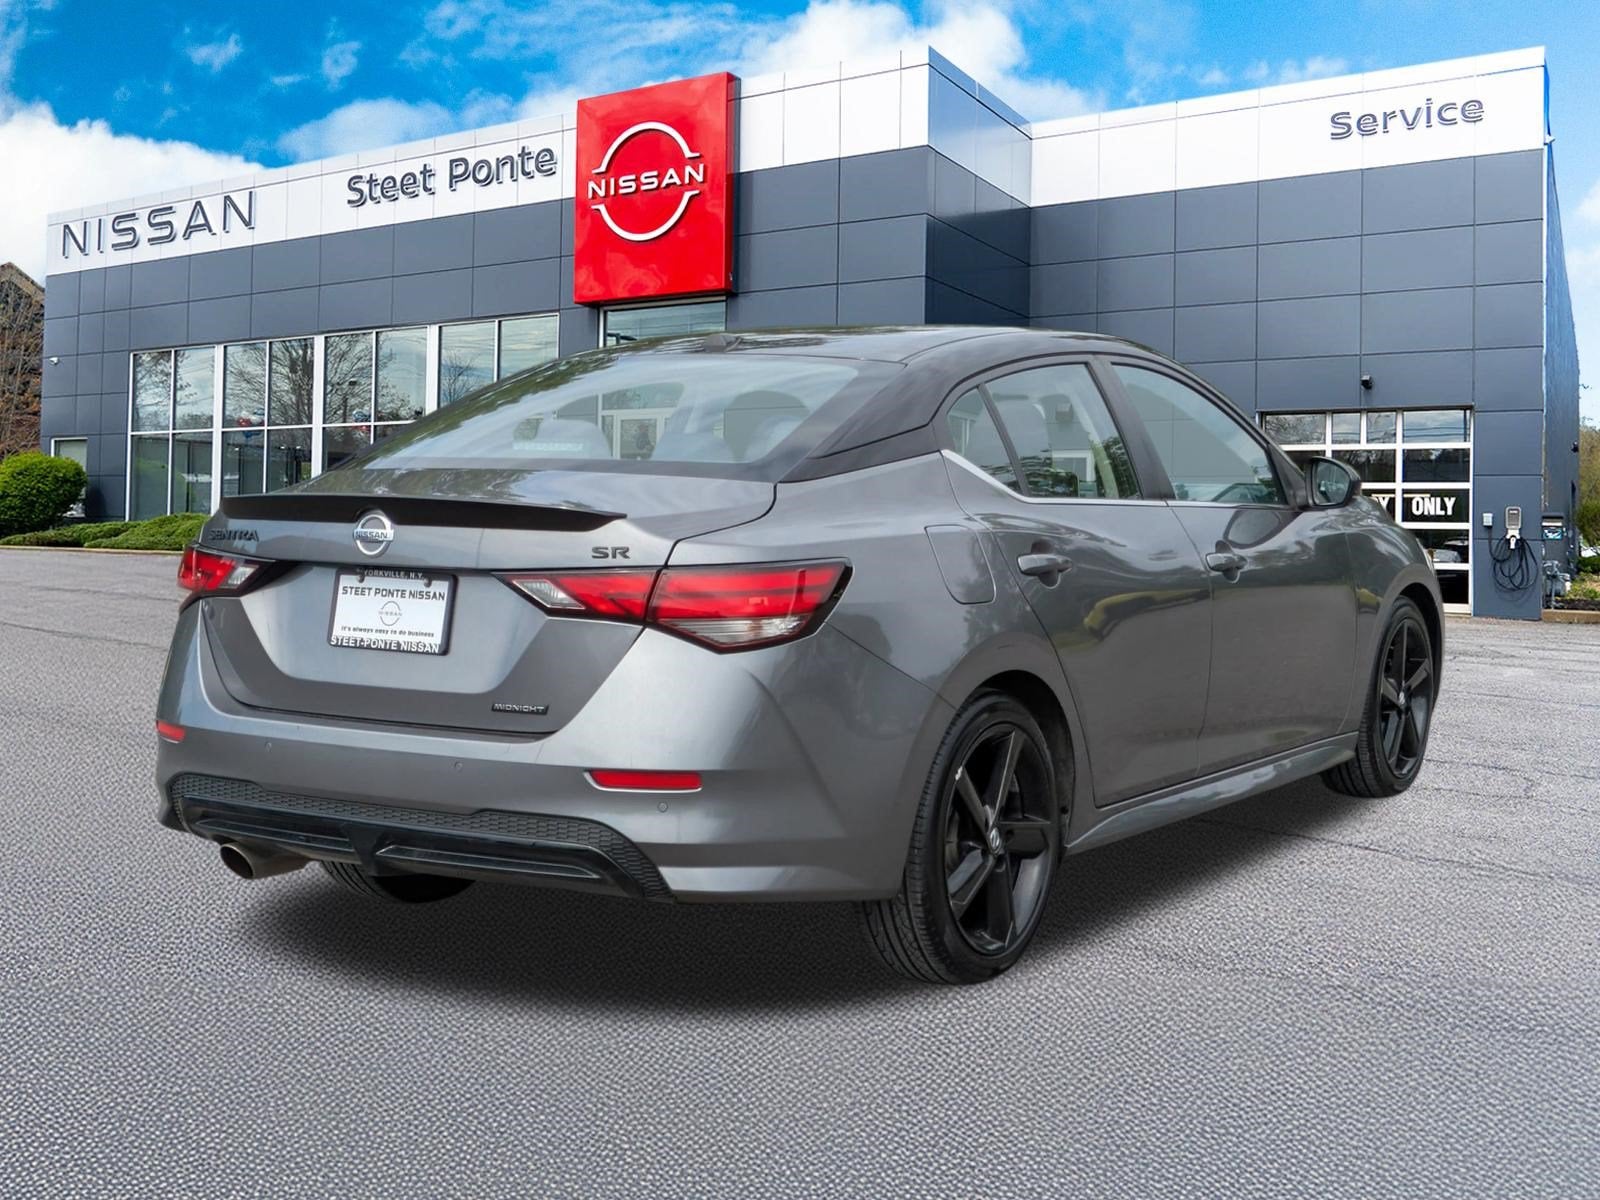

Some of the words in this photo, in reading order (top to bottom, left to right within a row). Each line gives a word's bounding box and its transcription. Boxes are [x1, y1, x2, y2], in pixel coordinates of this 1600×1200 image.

[1330, 98, 1484, 140] Service
[347, 162, 435, 207] Steet
[449, 146, 557, 193] Ponte
[587, 163, 705, 200] NISSAN
[62, 190, 256, 259] NISSAN
[1411, 496, 1456, 516] ONLY
[209, 529, 259, 542] SENTRA
[355, 530, 389, 540] NISSAN
[591, 546, 631, 559] SR
[342, 586, 372, 596] STEET
[374, 588, 406, 598] PONTE
[408, 590, 445, 600] NISSAN
[400, 641, 439, 654] NISSAN
[494, 703, 545, 712] MIDNIGHT
